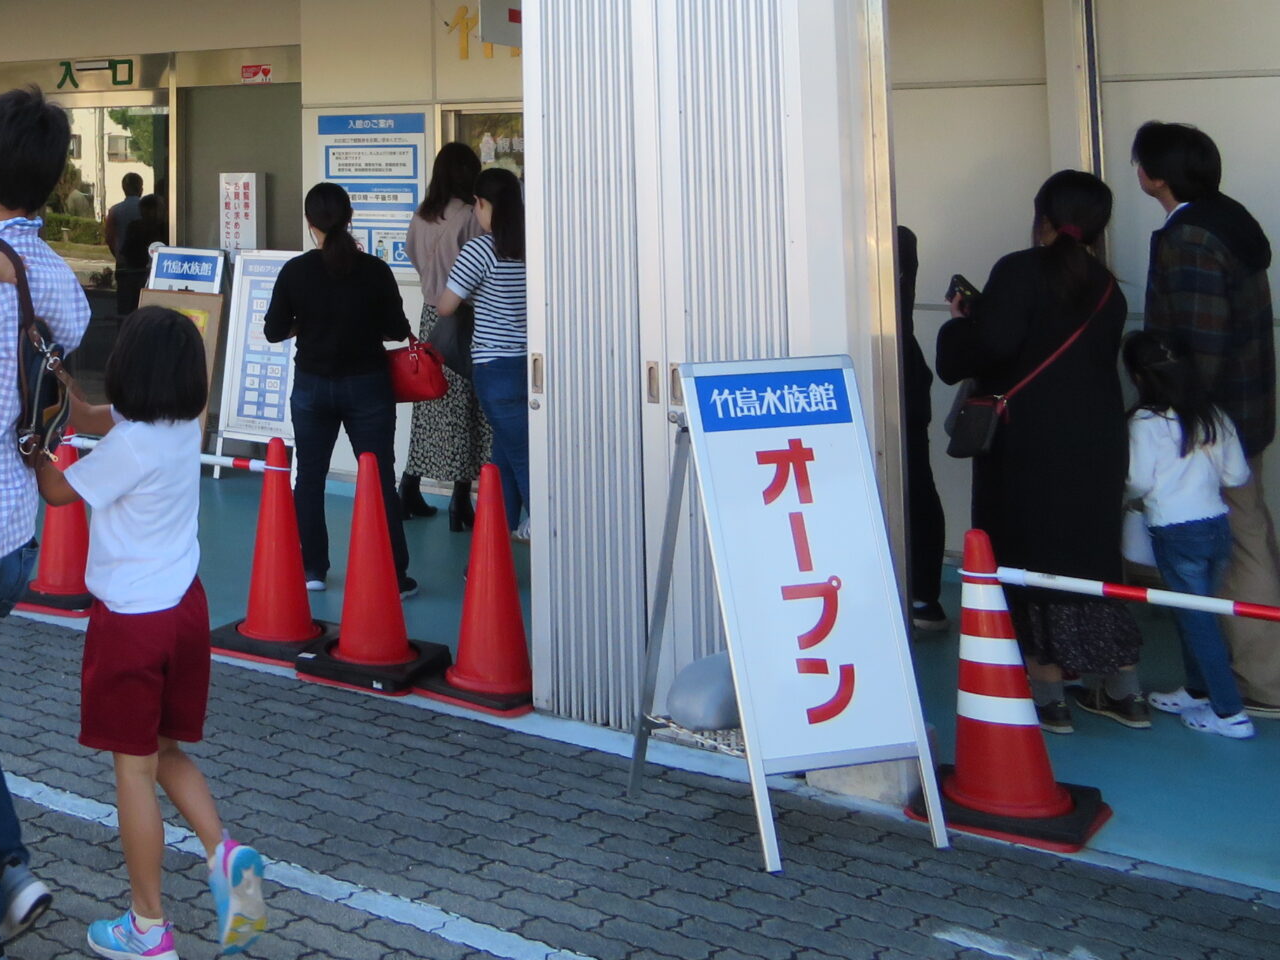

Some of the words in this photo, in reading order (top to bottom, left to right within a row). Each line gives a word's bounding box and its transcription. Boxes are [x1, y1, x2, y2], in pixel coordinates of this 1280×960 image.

[57, 59, 133, 90] 入口
[163, 259, 212, 276] 竹島水族館
[709, 382, 837, 419] 竹島水族館
[755, 438, 856, 725] オープン
